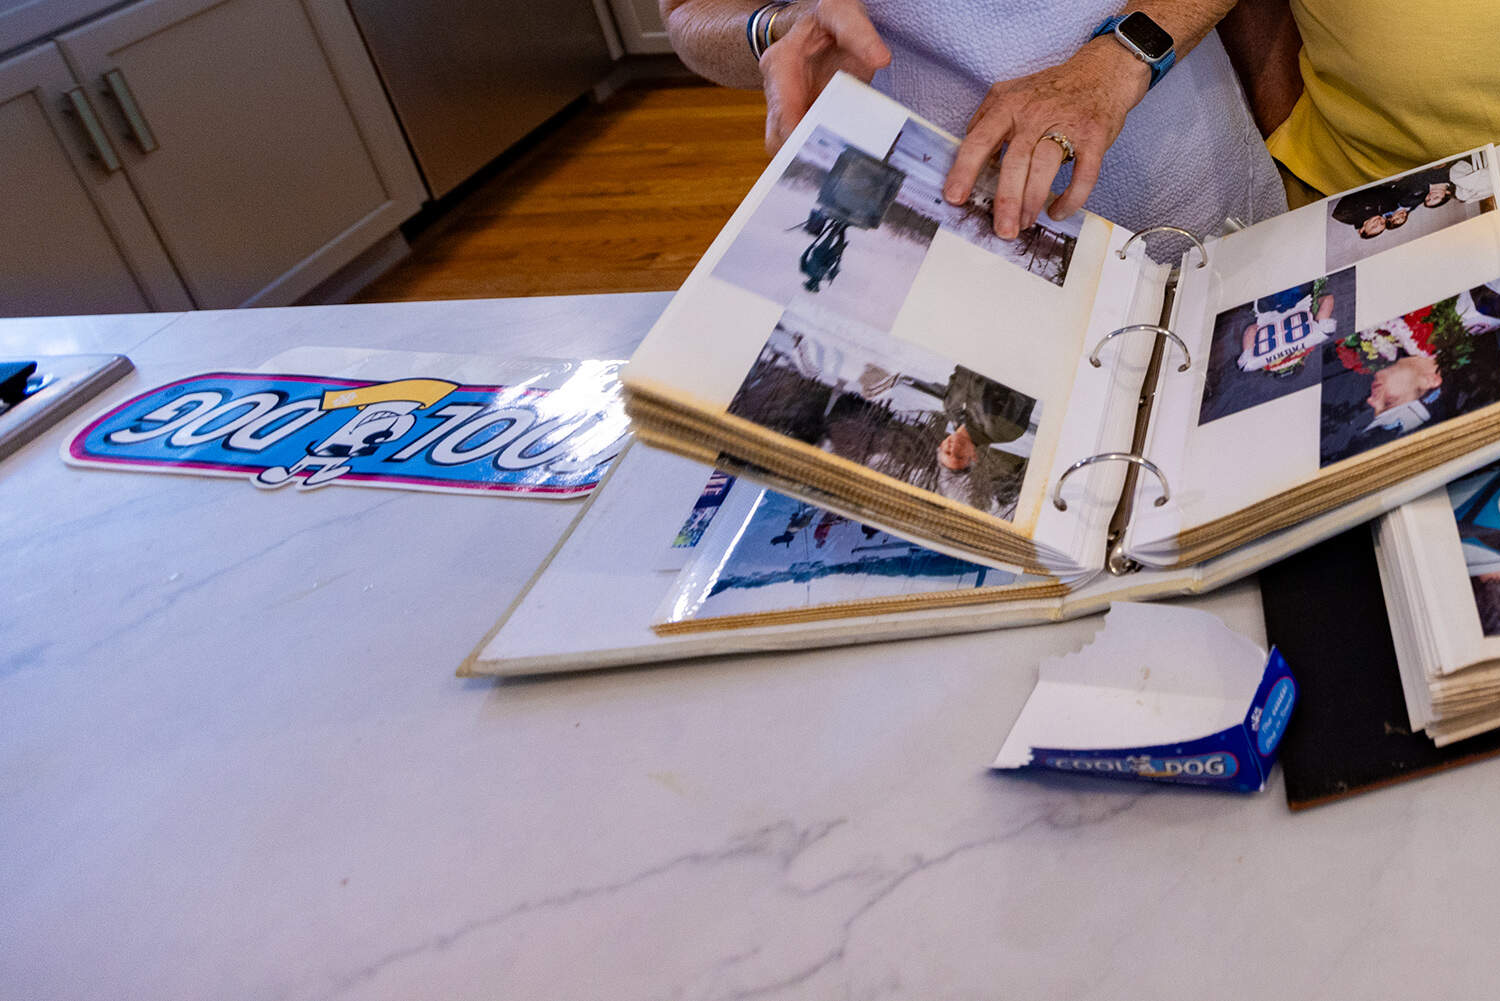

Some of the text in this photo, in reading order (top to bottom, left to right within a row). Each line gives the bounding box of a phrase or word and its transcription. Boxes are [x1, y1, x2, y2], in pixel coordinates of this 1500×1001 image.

[108, 390, 318, 453] DOG
[1055, 756, 1225, 777] COOL DOG
